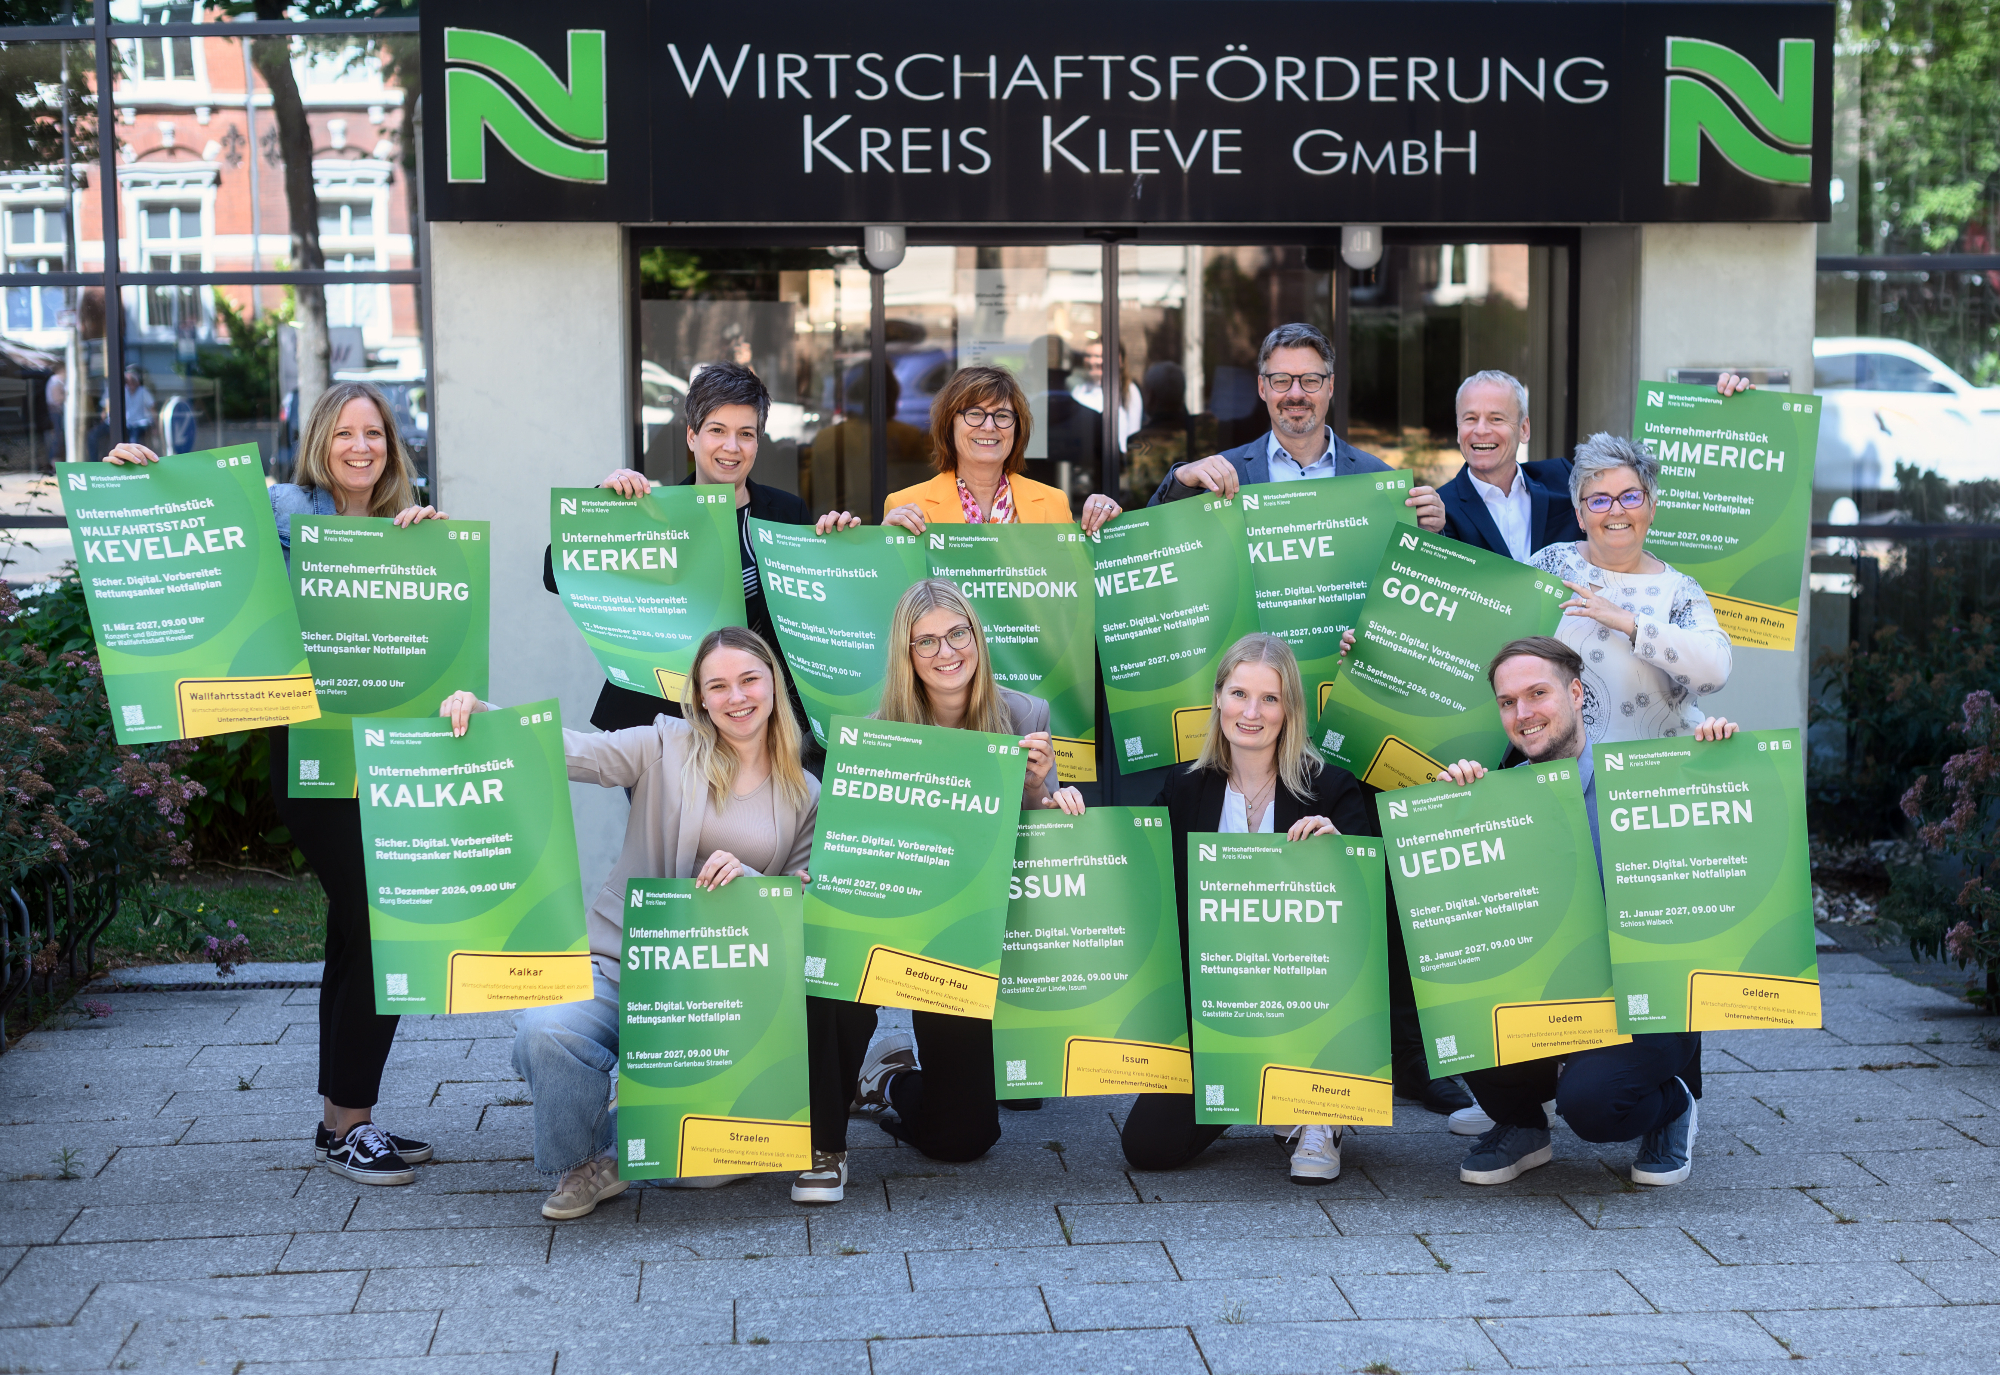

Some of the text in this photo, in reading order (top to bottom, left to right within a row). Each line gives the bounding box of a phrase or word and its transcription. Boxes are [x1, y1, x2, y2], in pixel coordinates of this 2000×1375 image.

[1644, 422, 1769, 444] Unternehmerfrühstück
[1661, 466, 1696, 478] RHEIN
[1670, 488, 1701, 500] Digital.
[1703, 491, 1754, 505] Vorbereitet:
[76, 498, 214, 519] Unternehmerfrühstück
[1702, 501, 1751, 516] Notfallplan
[80, 517, 206, 536] WALLFAHRTSSTADT
[1247, 516, 1369, 536] Unternehmerfrühstück
[562, 530, 690, 543] Unternehmerfrühstück
[1646, 538, 1713, 549] Kunstforum Niederrhein
[1677, 532, 1698, 540] 2027,
[1701, 534, 1723, 542] 09.00
[1725, 536, 1739, 544] Uhr
[83, 526, 246, 563] KEVELAER
[1248, 535, 1334, 564] KLEVE
[563, 546, 678, 571] KERKEN
[302, 561, 437, 576] Unternehmerfrühstück
[765, 557, 878, 578] Unternehmerfrühstück
[932, 566, 1047, 577] Unternehmerfrühstück
[92, 567, 222, 587] Sicher. Digital. Vorbereitet:
[1095, 562, 1178, 597] WEEZE
[95, 580, 222, 598] Rettungsanker Notfallplan
[301, 578, 469, 601] KRANENBURG
[768, 572, 826, 602] REES
[957, 580, 1078, 598] CHTENDONK
[1316, 580, 1367, 593] Vorbereitet:
[1391, 560, 1513, 616] Unternehmerfrühstück
[635, 596, 688, 604] Vorbereitet:
[1319, 592, 1366, 603] Notfallplan
[1382, 577, 1458, 622] GOCH
[639, 605, 687, 615] Notfallplan
[102, 616, 205, 631] 11. März 2027, 09.00 Uhr
[994, 624, 1041, 633] Vorbereitet:
[302, 632, 429, 643] Sicher. Digital. Vorbereitet:
[828, 628, 876, 639] Vorbereitet:
[995, 635, 1039, 644] Notfallplan
[373, 646, 426, 656] Notfallplan
[831, 638, 875, 650] Notfallplan
[1120, 659, 1146, 671] Februar
[1148, 655, 1169, 665] 2027,
[1171, 650, 1192, 660] 09.00
[1193, 647, 1206, 655] Uhr
[315, 679, 334, 688] April
[337, 680, 360, 688] 2027,
[1111, 671, 1140, 681] Petrusheim
[1353, 659, 1467, 712] 23. September 2026, 09.00 Uhr
[190, 690, 312, 700] Wallfahrtsstadt Kevelaer
[1629, 751, 1691, 760] Wirtschaftsförderung
[369, 758, 515, 777] Unternehmerfrühstück
[836, 762, 972, 788] Unternehmerfrühstück
[370, 779, 504, 807] KALKAR
[832, 778, 1000, 815] BEDBURG-HAU
[1609, 781, 1750, 801] Unternehmerfrühstück
[1610, 799, 1753, 832] GELDERN
[1396, 814, 1534, 848] Unternehmerfrühstück
[1400, 837, 1506, 878] UEDEM
[395, 887, 440, 895] Dezember
[441, 887, 468, 895] 2026,
[470, 884, 498, 893] 09.00
[499, 882, 516, 890] Uhr
[817, 883, 886, 899] Café Happy Chocolate
[818, 874, 922, 896] 15. April 2027, 09.00 Uhr
[1009, 874, 1086, 899] SSUM
[1200, 881, 1336, 893] Unternehmerfrühstück
[1200, 899, 1343, 923] RHEURDT
[1619, 904, 1735, 919] 21. Januar 2027, 09.00 Uhr
[1646, 918, 1673, 926] Walbeck
[629, 926, 749, 939] Unternehmerfrühstück
[627, 944, 768, 970] STRAELEN
[1419, 935, 1533, 964] 28. Januar 2027, 09.00 Uhr
[1421, 955, 1481, 972] Bürgerhaus Uedem
[509, 967, 543, 977] Kalkar
[905, 967, 968, 991] Bedburg-Hau
[1002, 977, 1015, 985] 03.
[1016, 976, 1059, 984] November
[1061, 975, 1085, 983] 2026,
[1087, 973, 1111, 981] 09.00
[1742, 988, 1780, 999] Geldern
[1216, 1001, 1258, 1009] November
[1260, 1002, 1285, 1010] 2026,
[1548, 1014, 1583, 1024] Uedem
[636, 1051, 662, 1059] Februar
[664, 1050, 686, 1059] 2027,
[688, 1049, 711, 1057] 09.00
[1122, 1054, 1149, 1065] Issum
[627, 1059, 732, 1069] Versuchszentrum Gartenbau Straelen
[1311, 1084, 1351, 1097] Rheurdt
[729, 1132, 769, 1143] Straelen
